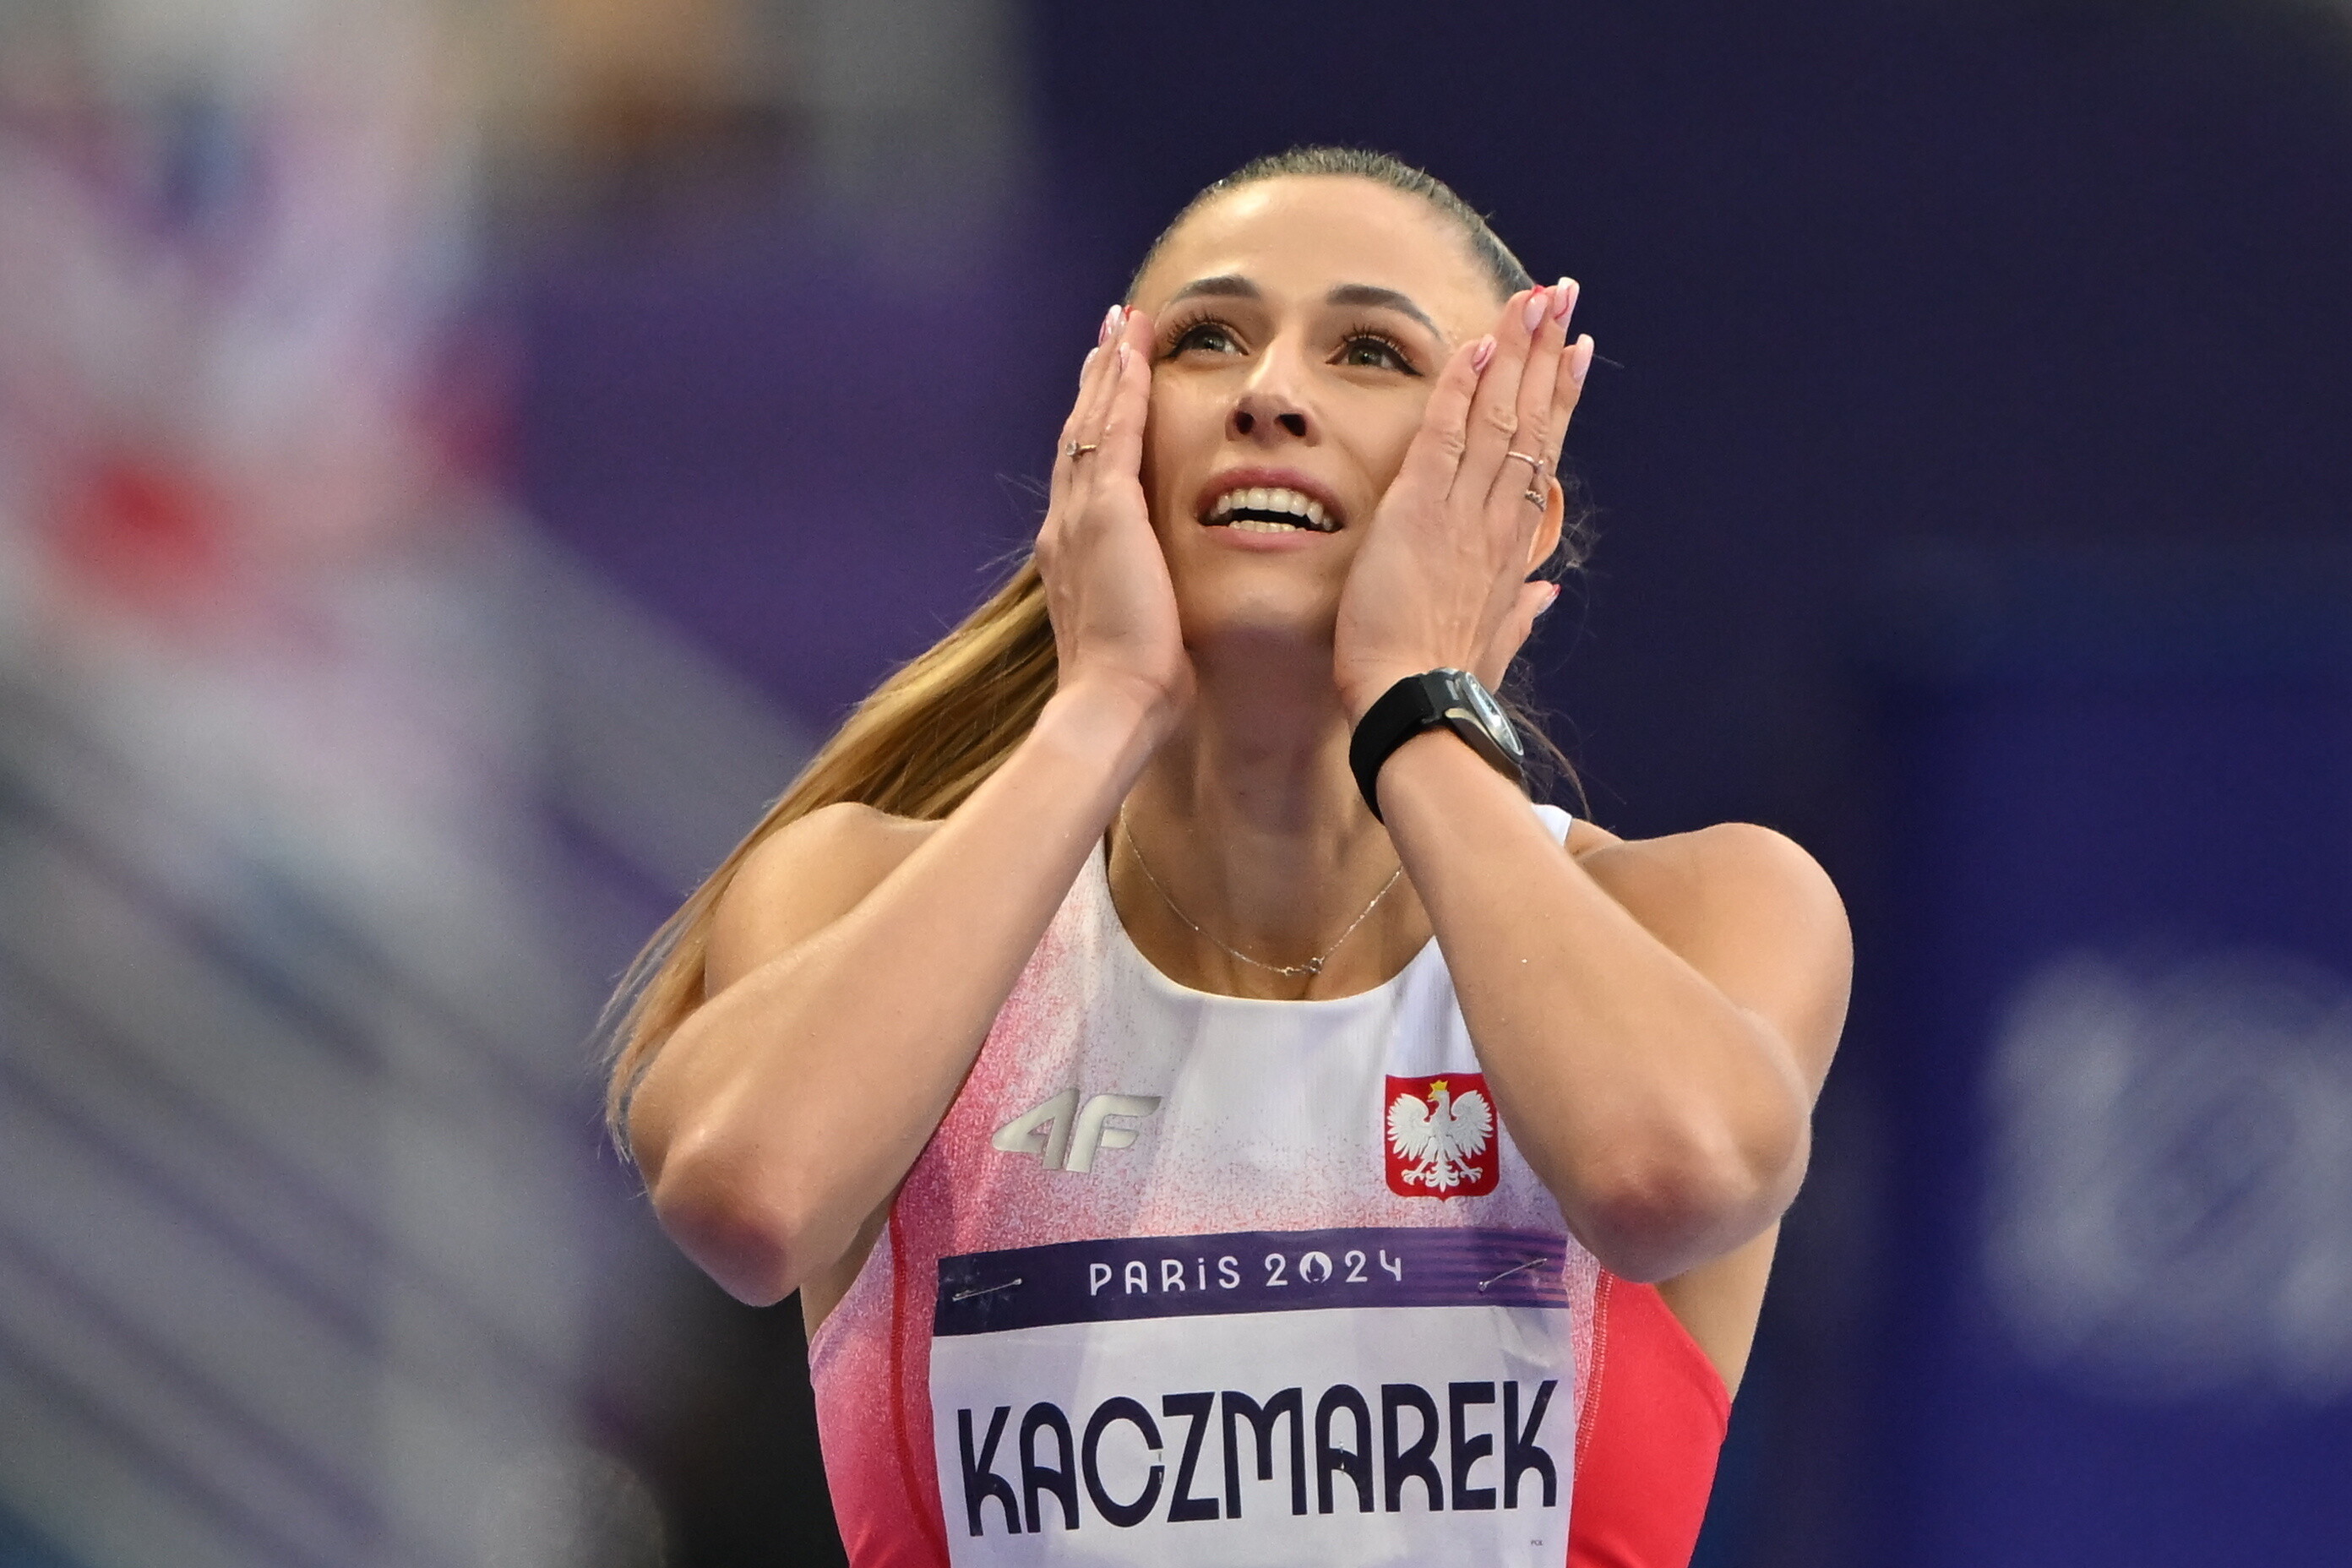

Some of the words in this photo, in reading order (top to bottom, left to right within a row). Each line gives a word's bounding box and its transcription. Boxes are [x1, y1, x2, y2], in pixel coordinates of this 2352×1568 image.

[991, 1087, 1162, 1173] 4F
[1264, 1250, 1402, 1287] 2024
[957, 1380, 1558, 1536] KACZMAREK
